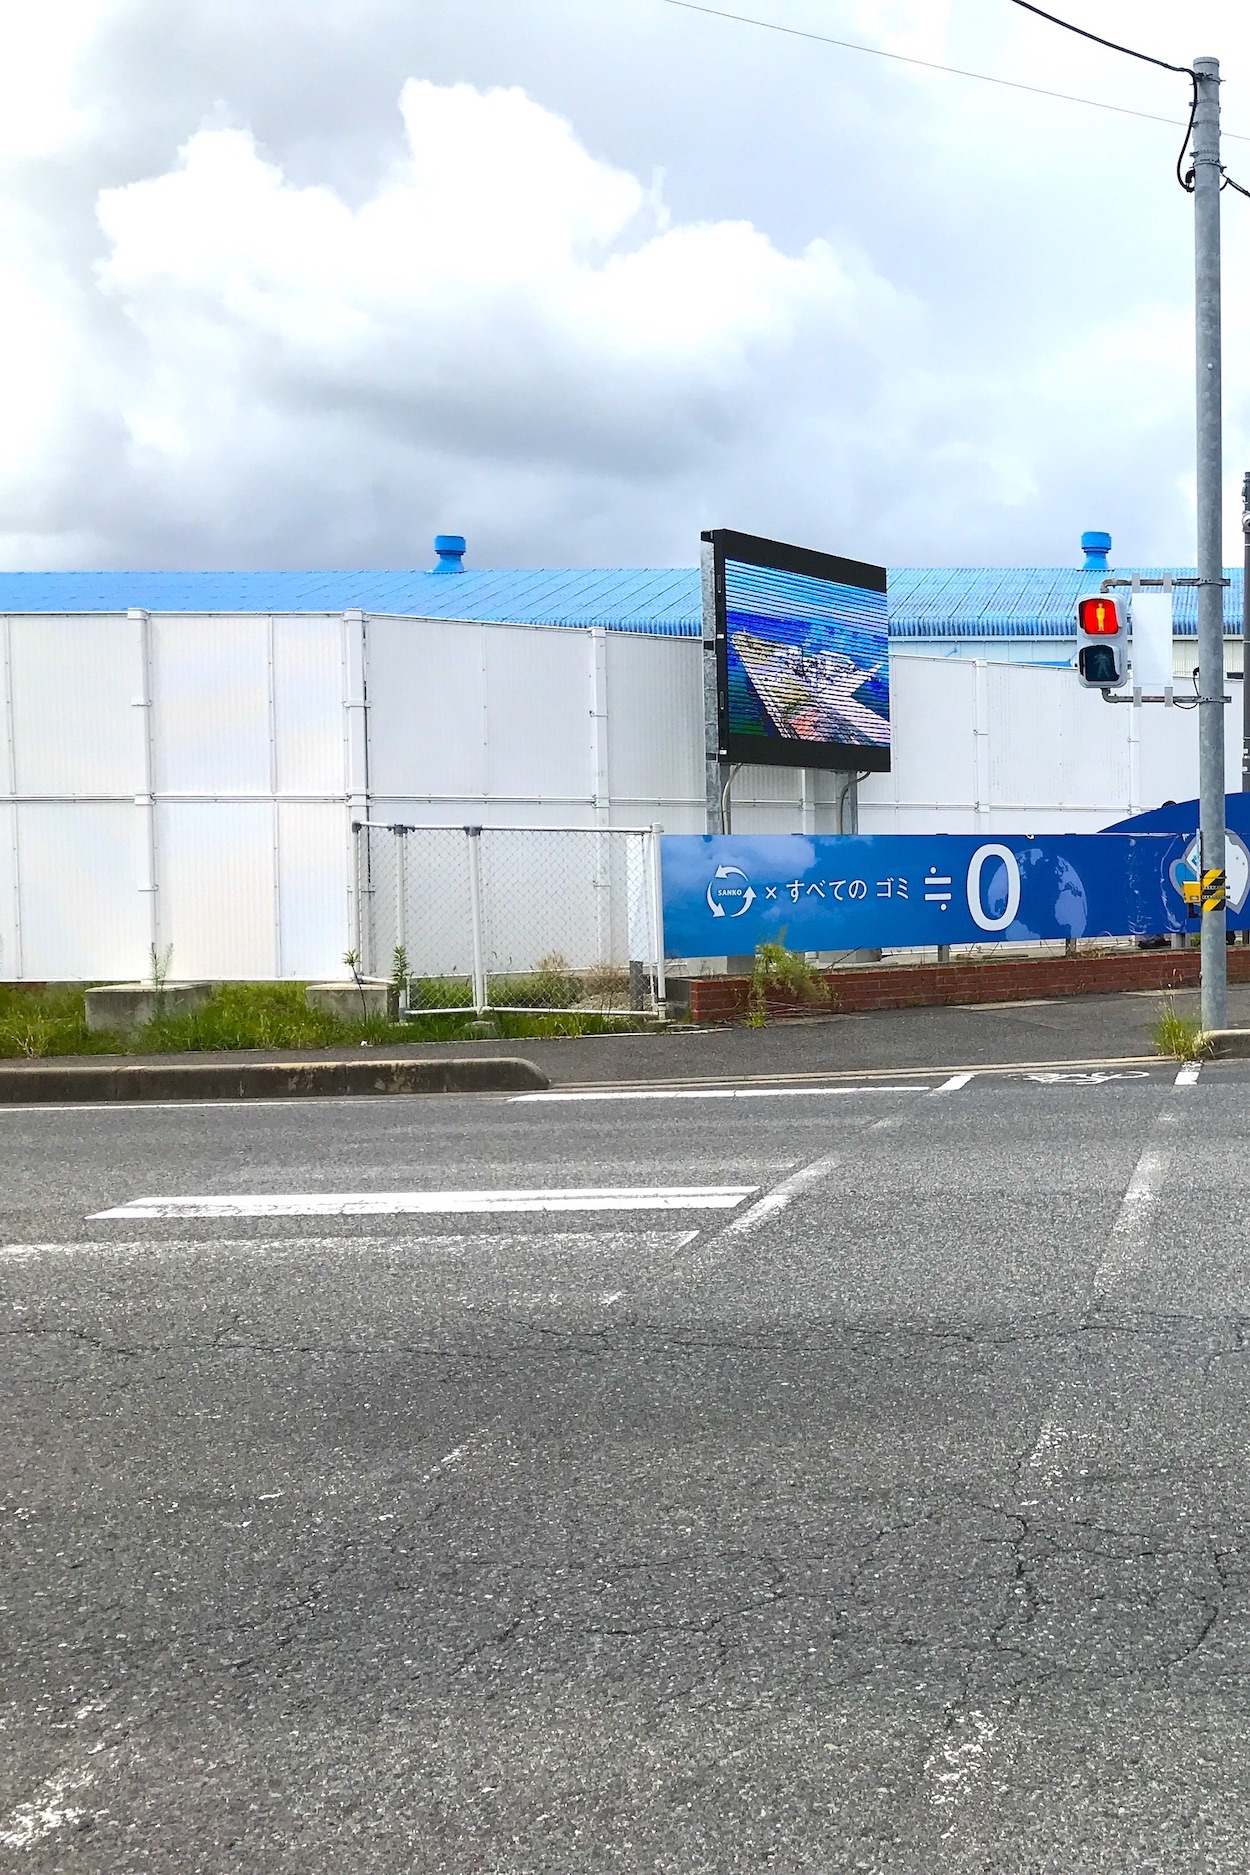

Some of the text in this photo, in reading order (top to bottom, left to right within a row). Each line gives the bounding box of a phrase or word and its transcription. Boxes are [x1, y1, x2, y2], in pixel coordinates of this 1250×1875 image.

[717, 889, 742, 897] SANKO
[785, 879, 868, 904] すべての
[876, 877, 909, 900] ゴミ
[966, 843, 1021, 931] 0
